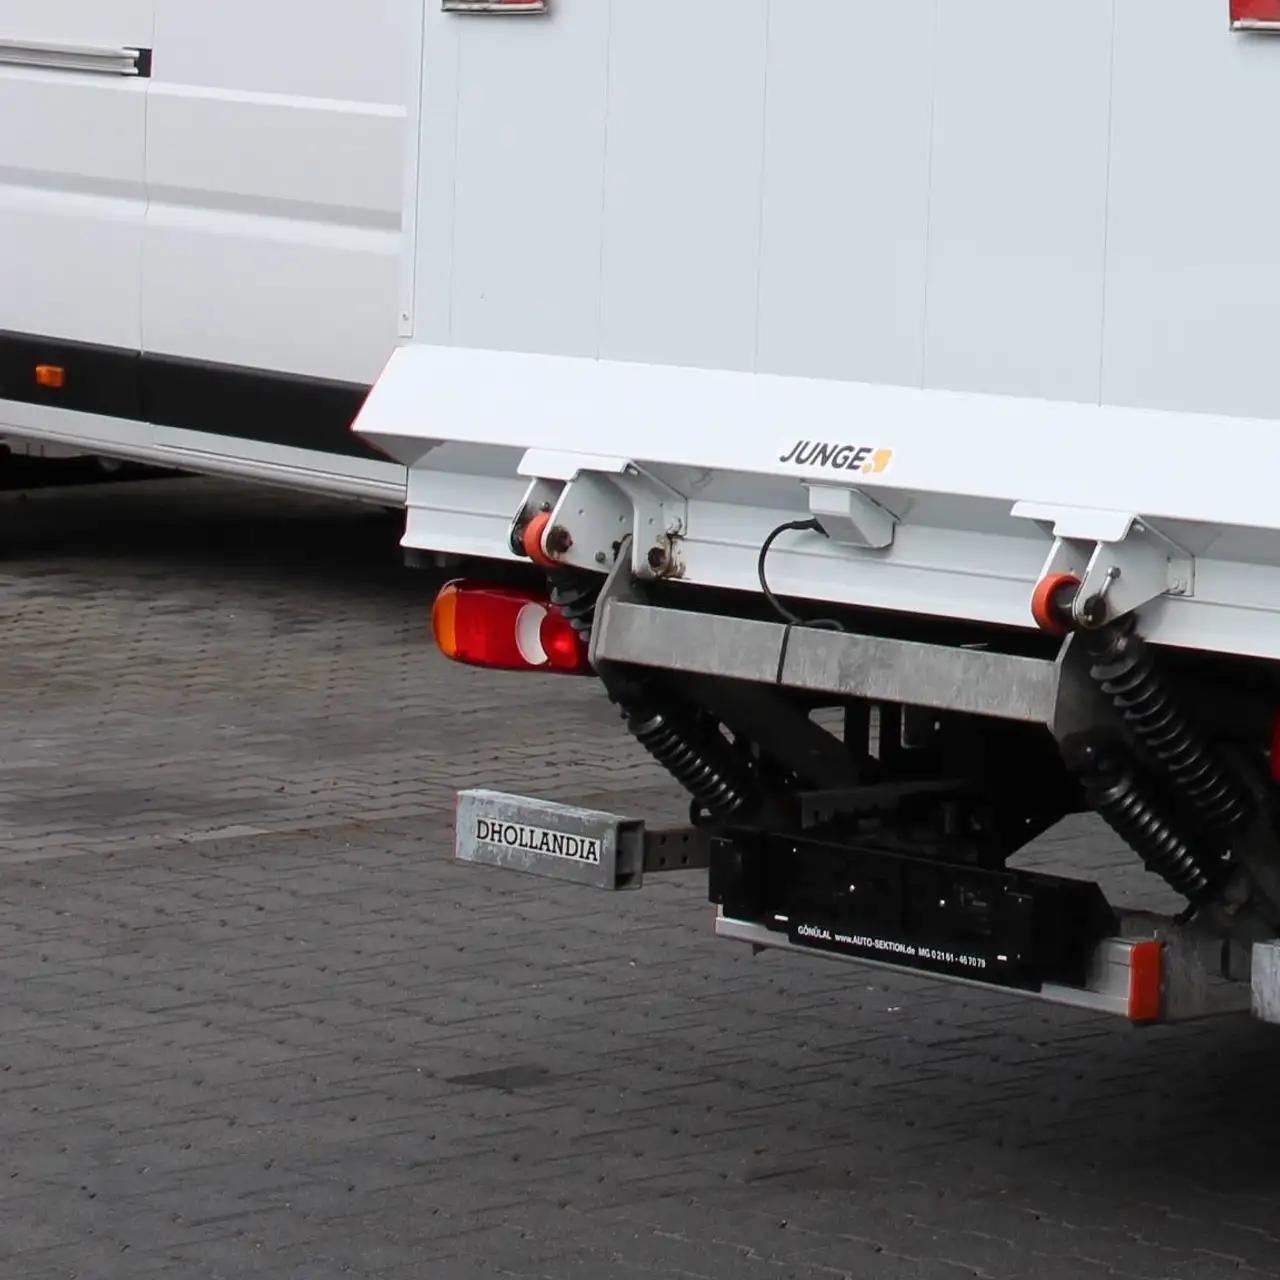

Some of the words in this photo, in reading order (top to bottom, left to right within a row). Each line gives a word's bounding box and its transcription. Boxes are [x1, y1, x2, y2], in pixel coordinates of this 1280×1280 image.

[779, 439, 873, 471] JUNGE
[476, 818, 599, 862] DHOLLANDIA
[797, 924, 831, 940] GÖNÜLAL
[835, 933, 916, 955] www.AUTO-SEKTION.de
